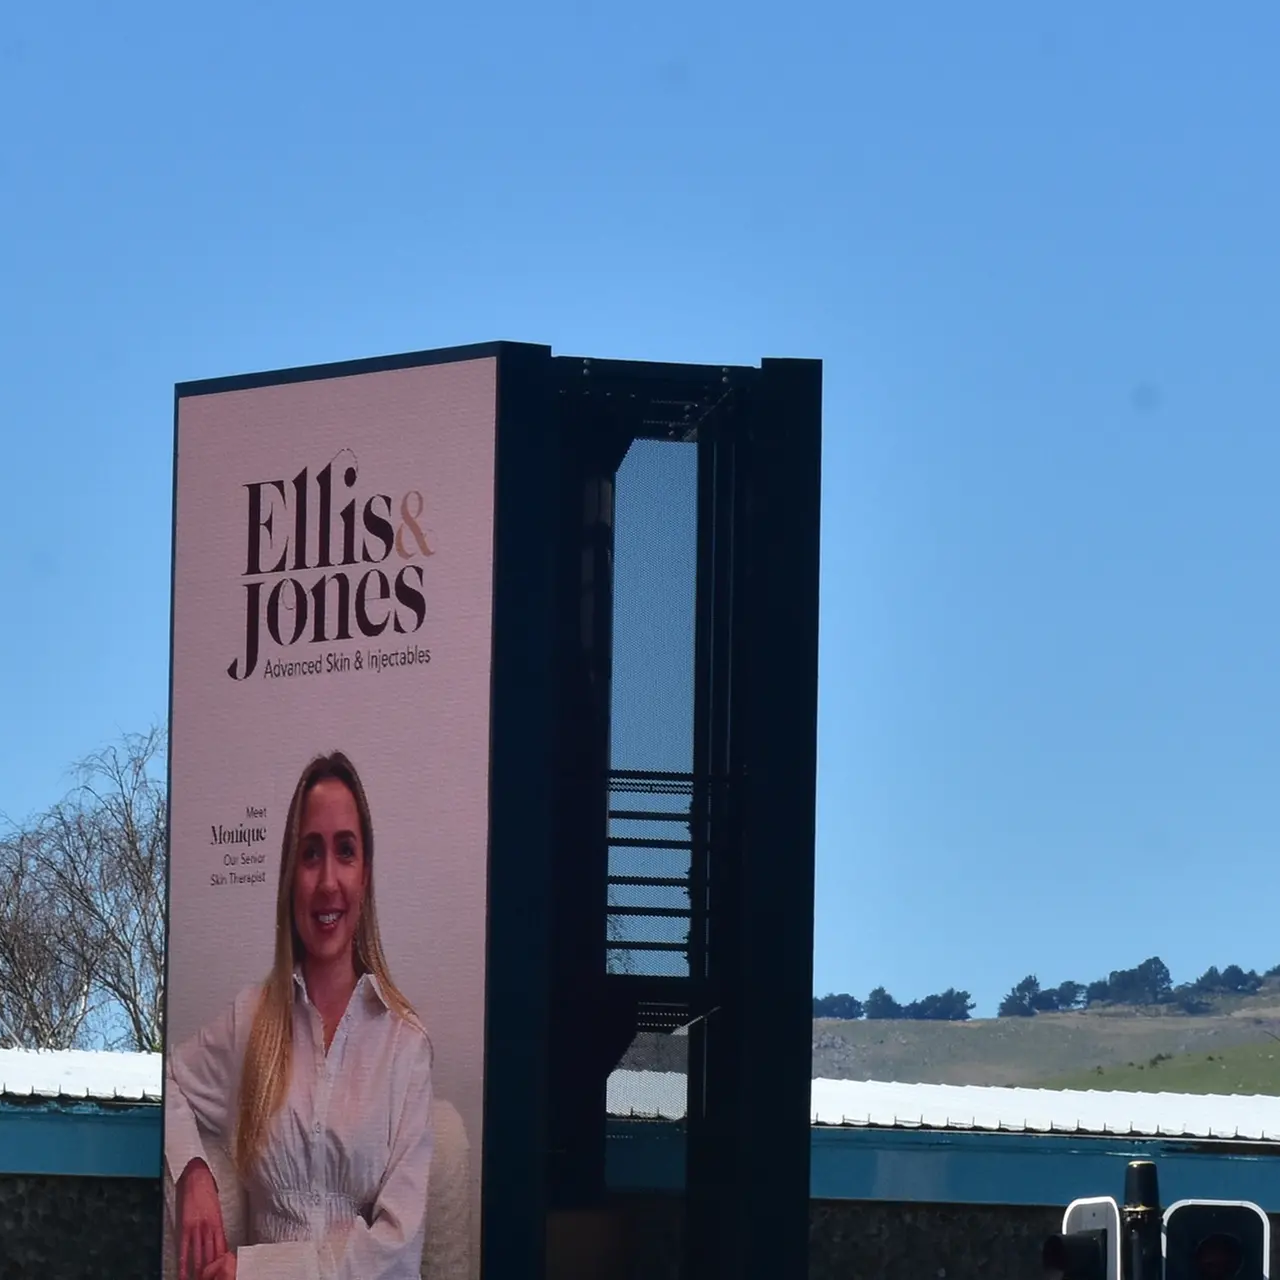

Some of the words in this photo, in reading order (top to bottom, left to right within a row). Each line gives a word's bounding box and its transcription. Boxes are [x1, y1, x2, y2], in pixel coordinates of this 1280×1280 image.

[264, 654, 322, 679] Advanced
[326, 651, 350, 674] Skin
[354, 653, 364, 671] &
[367, 645, 431, 674] Injectables
[246, 806, 267, 818] Meet
[210, 823, 267, 847] Monique
